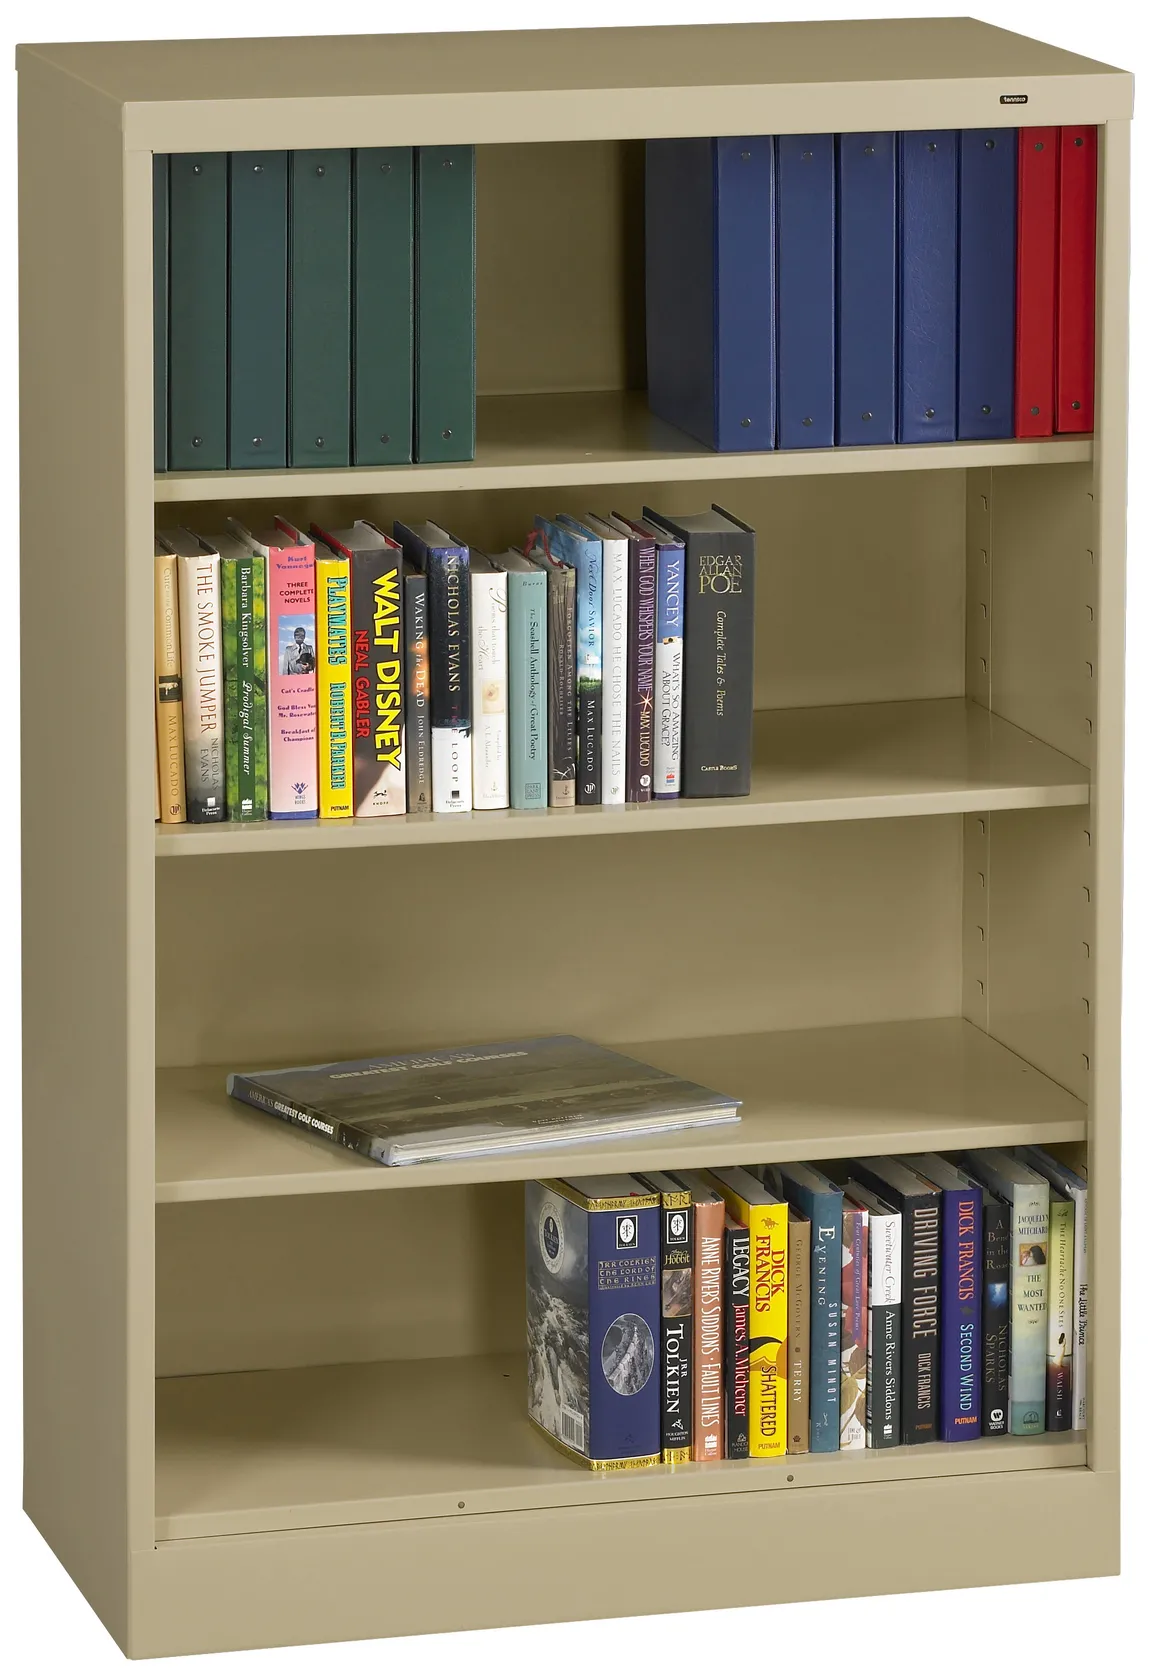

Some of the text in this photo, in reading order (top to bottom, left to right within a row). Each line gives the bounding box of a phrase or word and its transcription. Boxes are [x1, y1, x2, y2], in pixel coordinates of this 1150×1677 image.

[698, 573, 743, 594] POE
[699, 565, 742, 577] ALLAN
[700, 555, 743, 566] EDGAR
[279, 588, 314, 596] COMPLETE
[284, 596, 311, 604] NOVELS
[666, 560, 680, 628] YANCEY
[163, 567, 175, 668] Cure Common Life
[239, 567, 252, 668] Barbara Kingsolver
[327, 576, 348, 666] PLAYMATES
[415, 592, 425, 650] WAKING
[447, 555, 460, 692] NICHOLAS EVANS
[530, 621, 540, 655] Seashell
[196, 563, 217, 734] THE SMOKE JUMPER
[372, 568, 402, 772] WALT DISNEY
[415, 654, 424, 667] the
[584, 549, 600, 772] Next Door SAVIOR MAX LUCADO
[611, 553, 623, 776] MAX LUCADO HE CHOSE THE NAILS
[637, 546, 655, 767] WHEN GOD WHISPERS YOUR NAME MAX LUCADO
[713, 610, 727, 717] Complete Tales & Poems
[354, 630, 371, 738] NEAL GABLER
[416, 670, 426, 708] DEAD
[528, 656, 540, 699] Anthology
[239, 680, 254, 775] Prodigal Summer
[329, 681, 347, 730] ROBERT
[530, 707, 539, 732] Great
[661, 670, 672, 747] ABOUT GRACE?
[671, 652, 681, 761] WHAT'S SO AMAZING
[168, 715, 179, 797] MAX LUCADO
[200, 748, 209, 783] EVANS
[211, 738, 220, 791] NICHOLAS
[330, 742, 347, 790] PARKER
[418, 741, 426, 784] ELDREDGE
[451, 742, 459, 782] LOOP
[529, 733, 539, 761] Poetry
[329, 1051, 529, 1080] GREATEST GOLF COURSES
[274, 1101, 334, 1135] GREATEST GOLF COURSES
[995, 1219, 1004, 1230] A
[1018, 1213, 1049, 1225] JACQUELYN
[664, 1252, 690, 1266] Hobbit
[701, 1236, 721, 1266] ANNE
[817, 1225, 836, 1306] EVENING
[885, 1221, 896, 1274] Sweetwater
[986, 1247, 995, 1256] in
[1059, 1237, 1067, 1276] Heartache
[701, 1267, 721, 1305] RIVERS
[732, 1237, 750, 1341] LEGACY James
[755, 1234, 771, 1313] FRANCIS
[770, 1249, 786, 1297] DICK
[885, 1276, 896, 1304] Creek
[912, 1207, 939, 1339] DRIVING FORCE
[1023, 1289, 1044, 1298] MOST
[1027, 1273, 1042, 1283] THE
[793, 1239, 803, 1404] GEORGE TERRY
[885, 1310, 896, 1340] Anne
[958, 1200, 975, 1411] DICK FRANCIS SECOND WIND
[1078, 1283, 1088, 1346] The Little Prince
[701, 1306, 721, 1356] SIDDONS
[827, 1302, 838, 1403] SUSAN MINOT
[666, 1323, 685, 1414] TOLKIEN
[701, 1362, 721, 1394] FAULT
[885, 1342, 896, 1376] Rivers
[917, 1352, 932, 1410] DICK FRANCIS
[985, 1333, 998, 1384] SPARKS
[998, 1324, 1008, 1392] NICHOLAS
[701, 1396, 721, 1428] LINES
[761, 1364, 777, 1437] SHATTERED
[885, 1378, 896, 1421] Siddons
[954, 1416, 978, 1425] PUTNAM
[758, 1442, 781, 1450] PUTNAM
